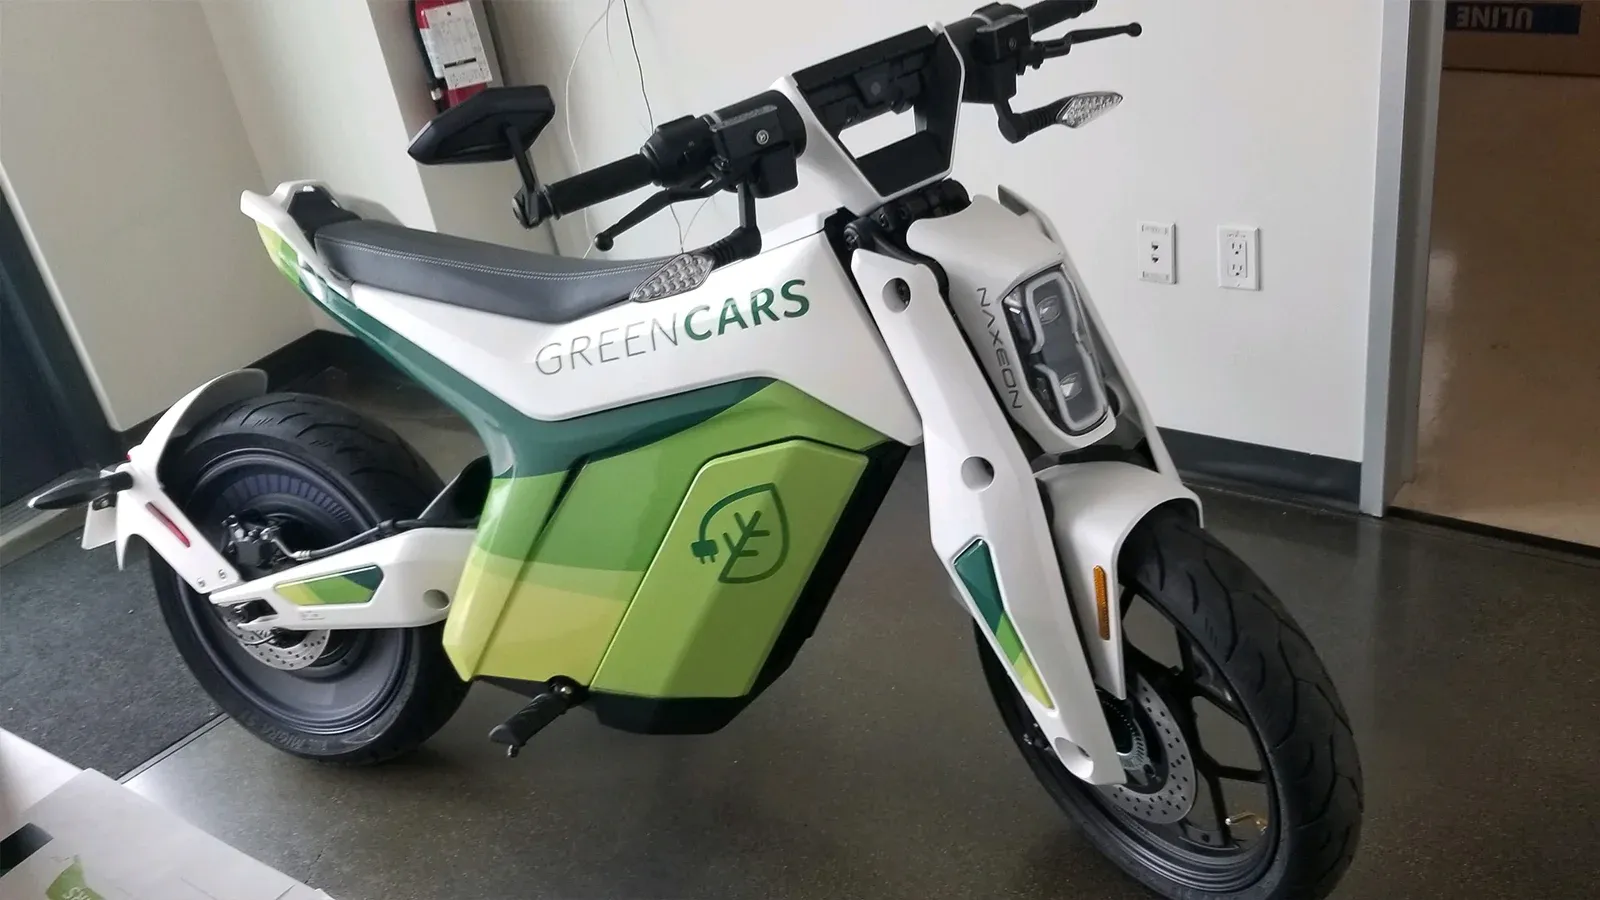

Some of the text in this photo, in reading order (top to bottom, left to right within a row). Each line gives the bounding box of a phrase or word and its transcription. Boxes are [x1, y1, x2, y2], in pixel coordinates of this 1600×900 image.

[1456, 5, 1534, 30] ULINE
[535, 279, 810, 375] GREENCARS
[976, 287, 1023, 409] NAXEON
